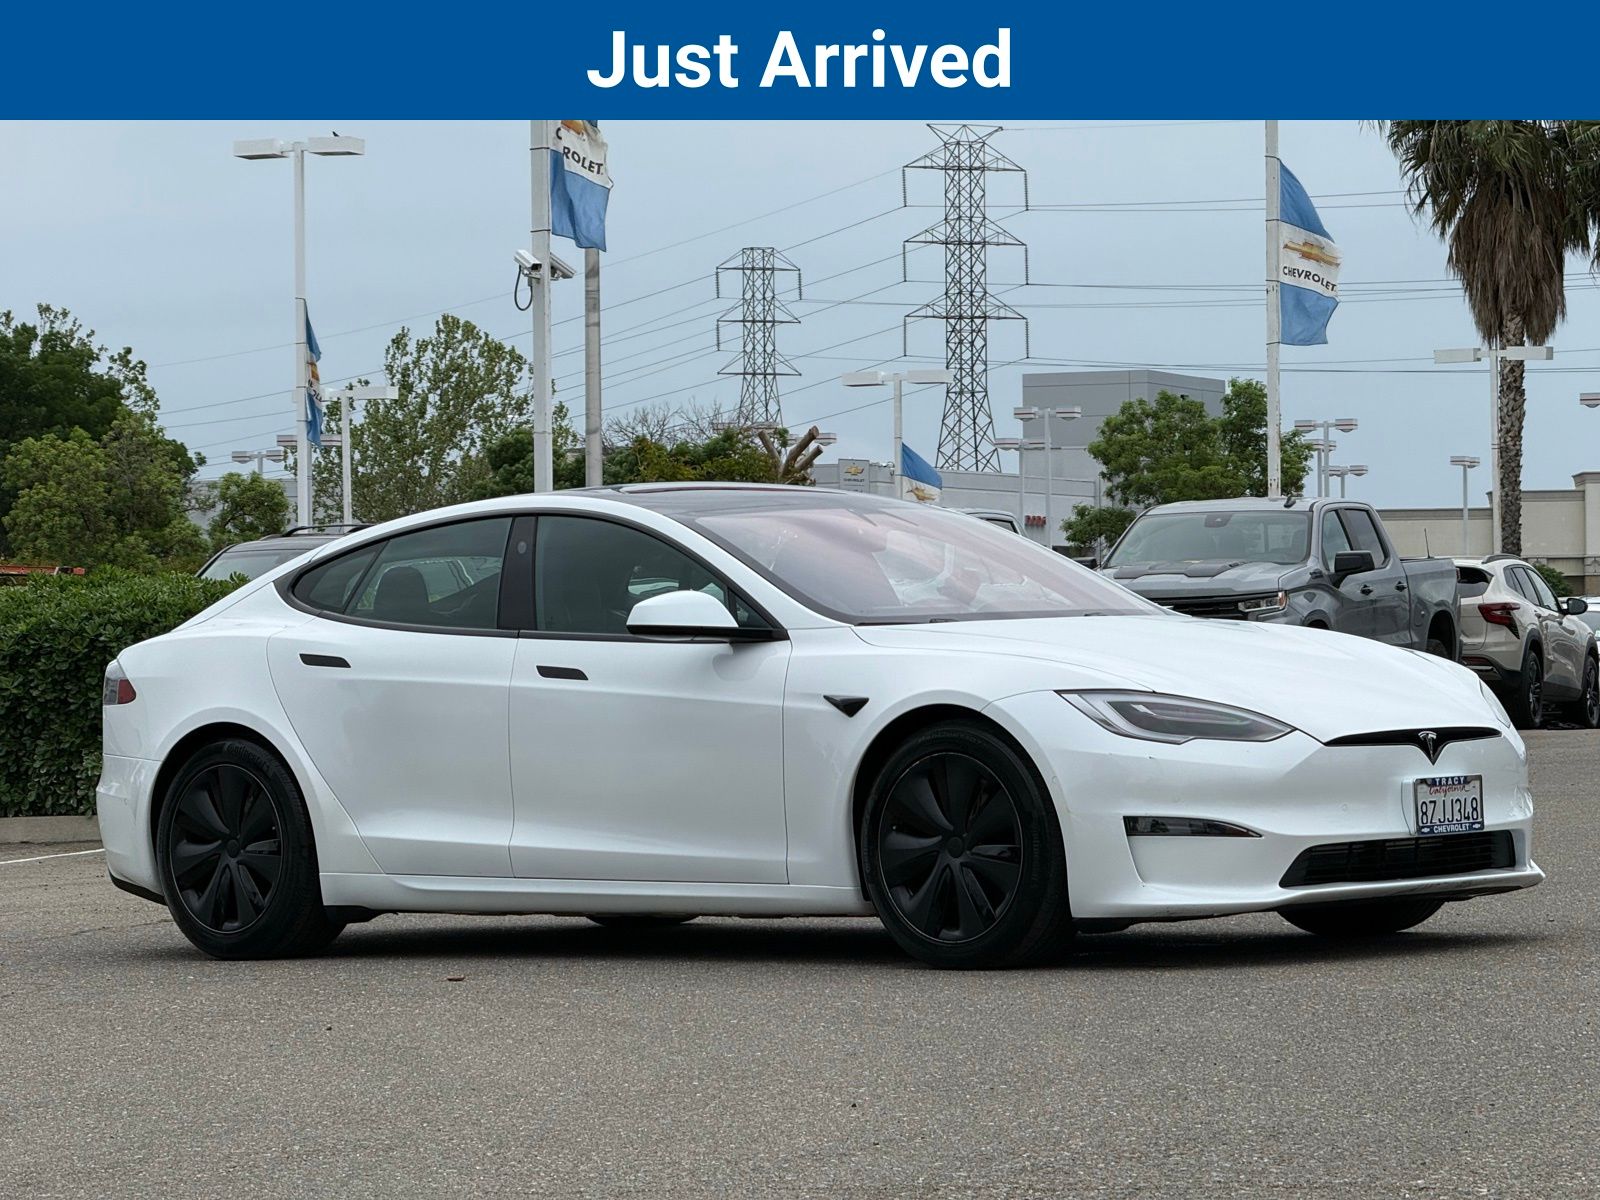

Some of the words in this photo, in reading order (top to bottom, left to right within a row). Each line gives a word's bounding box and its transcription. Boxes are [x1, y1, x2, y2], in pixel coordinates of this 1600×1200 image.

[1282, 265, 1337, 293] CHEVROLET
[1435, 776, 1465, 785] TRACY
[1420, 796, 1479, 825] 8ZJJ348
[1433, 823, 1469, 833] CHEVROLET
